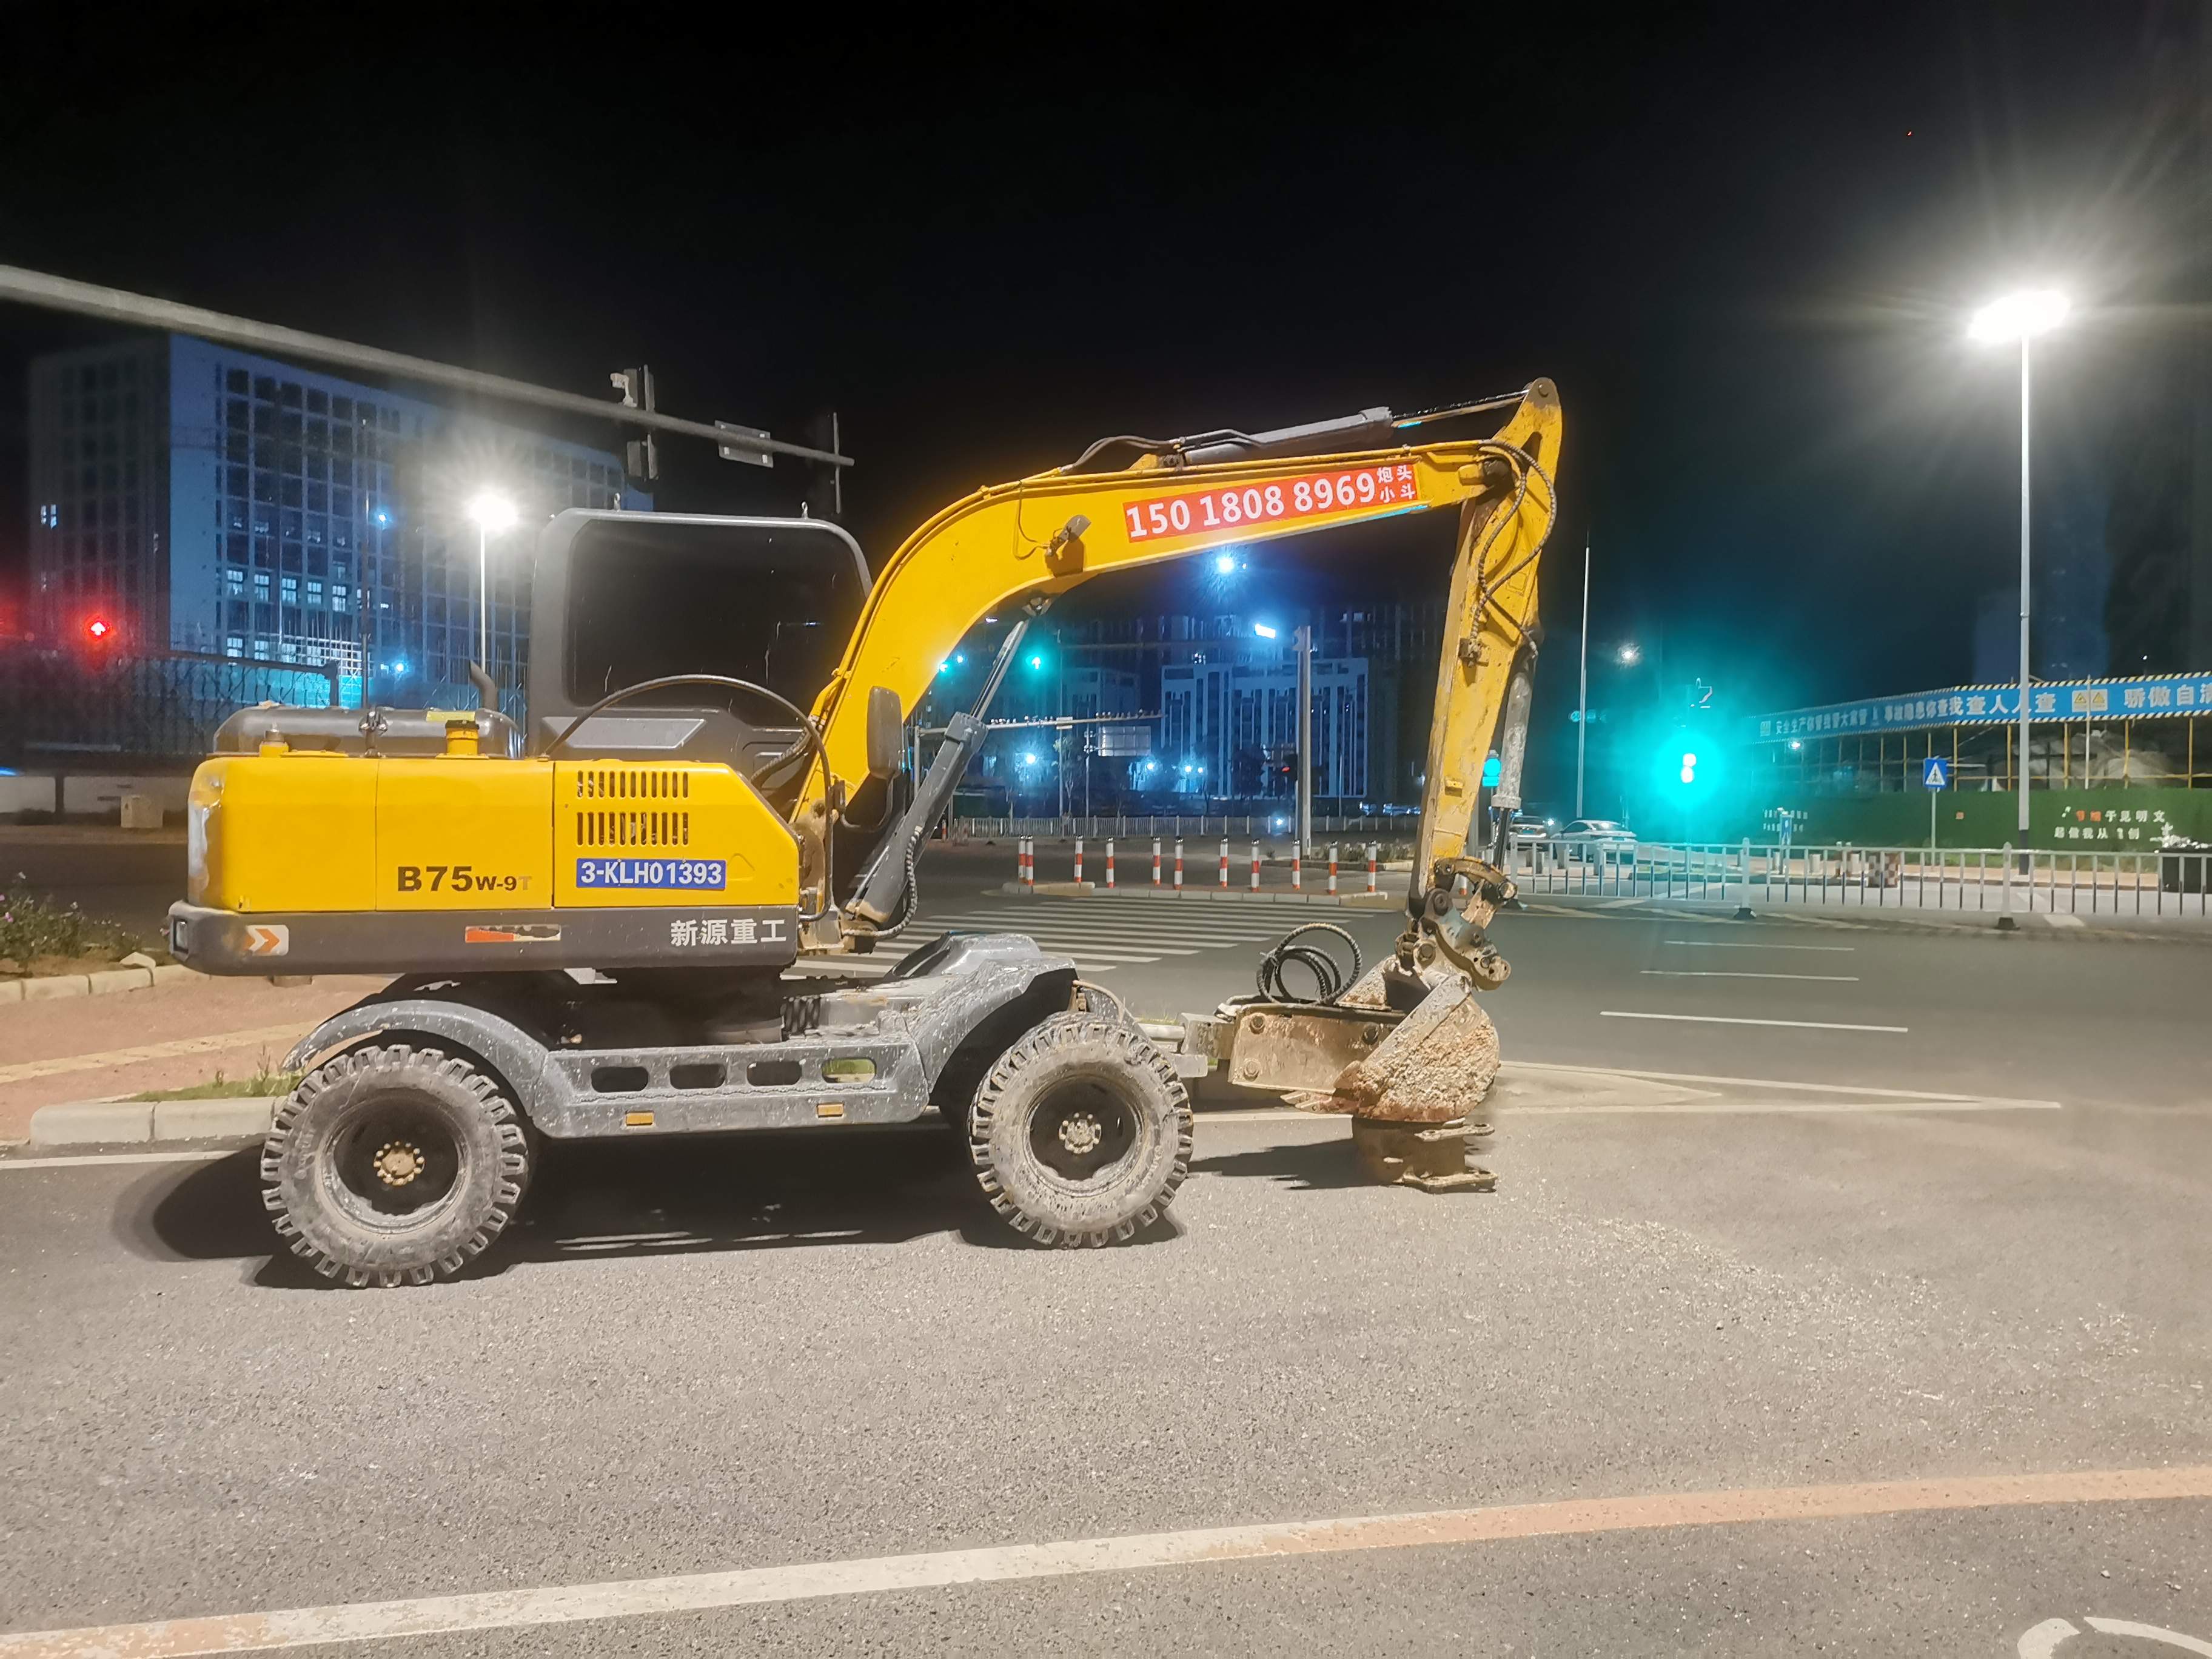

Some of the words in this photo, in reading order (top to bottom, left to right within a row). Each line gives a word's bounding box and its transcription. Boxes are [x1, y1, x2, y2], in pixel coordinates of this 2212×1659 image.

[1377, 464, 1412, 484] 炮头
[1126, 499, 1190, 538] 150
[1199, 486, 1284, 526] 1808
[1294, 472, 1375, 512] 8969
[1380, 483, 1416, 503] 小斗
[580, 861, 722, 885] 3-KLH01393
[670, 918, 786, 947] 新源重工
